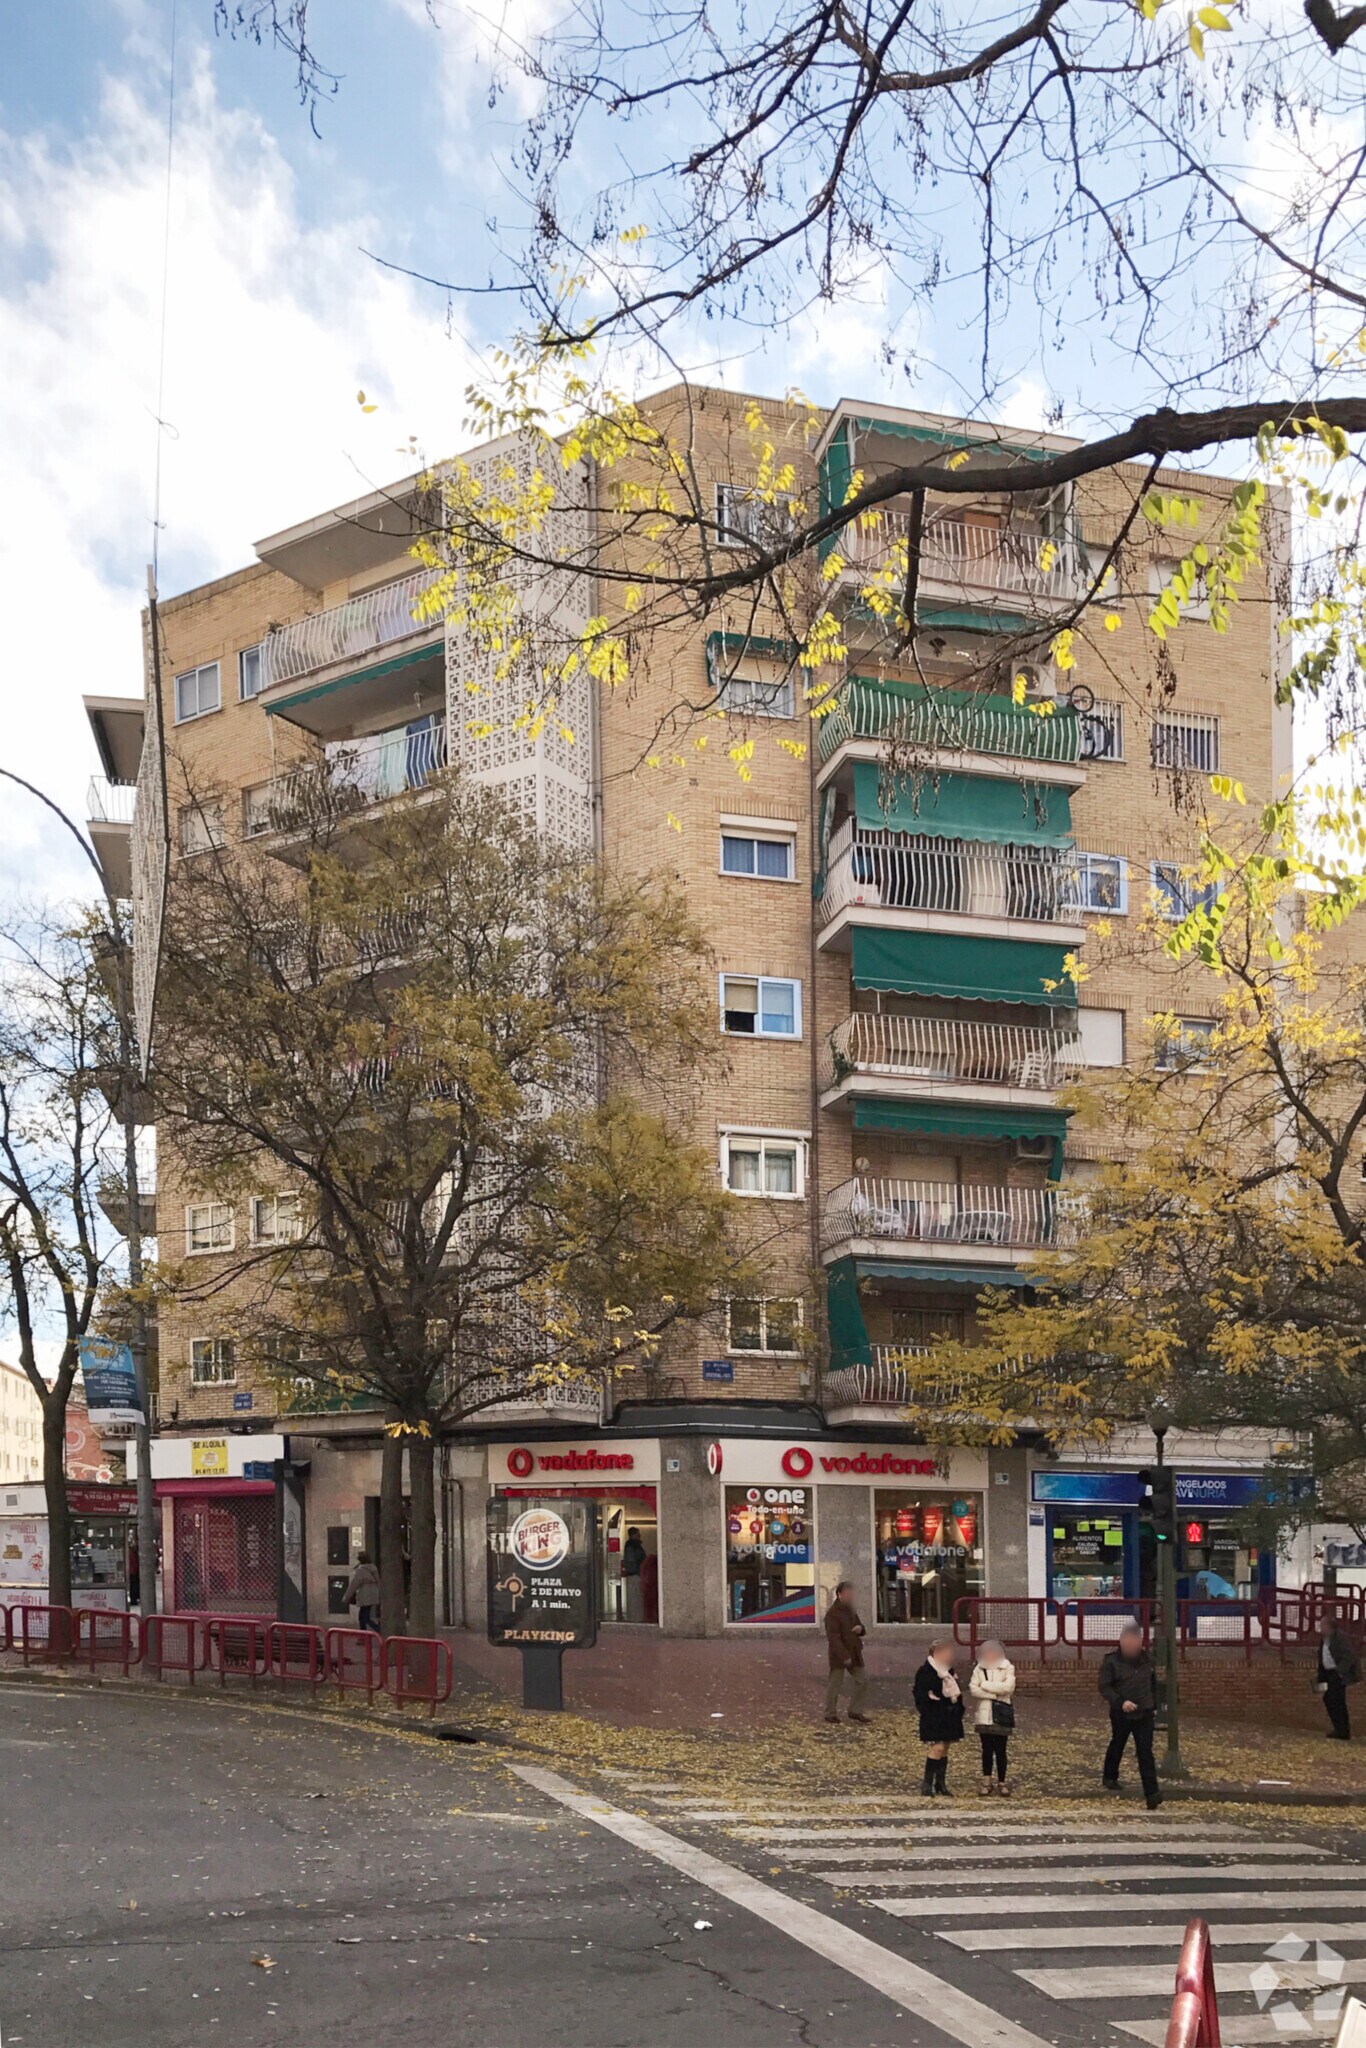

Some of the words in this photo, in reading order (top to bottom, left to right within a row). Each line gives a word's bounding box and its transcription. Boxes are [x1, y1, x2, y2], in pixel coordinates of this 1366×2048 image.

[193, 1441, 200, 1449] SE
[202, 1440, 226, 1448] ALQUILA
[537, 1449, 634, 1470] vodafone
[820, 1452, 936, 1474] vodafone
[1175, 1479, 1227, 1489] ONGELADOS
[764, 1488, 805, 1503] one
[1175, 1488, 1227, 1498] AVINURIA
[518, 1521, 560, 1542] BURGER
[520, 1531, 562, 1556] KING
[736, 1541, 806, 1554] vodafone
[896, 1543, 965, 1556] vodafone
[531, 1578, 562, 1586] PLAZA
[539, 1588, 553, 1596] DE
[553, 1588, 582, 1597] MAYO
[531, 1600, 539, 1608] A
[542, 1600, 547, 1608] 1
[549, 1600, 571, 1609] min.
[504, 1629, 576, 1642] PLAYKING
